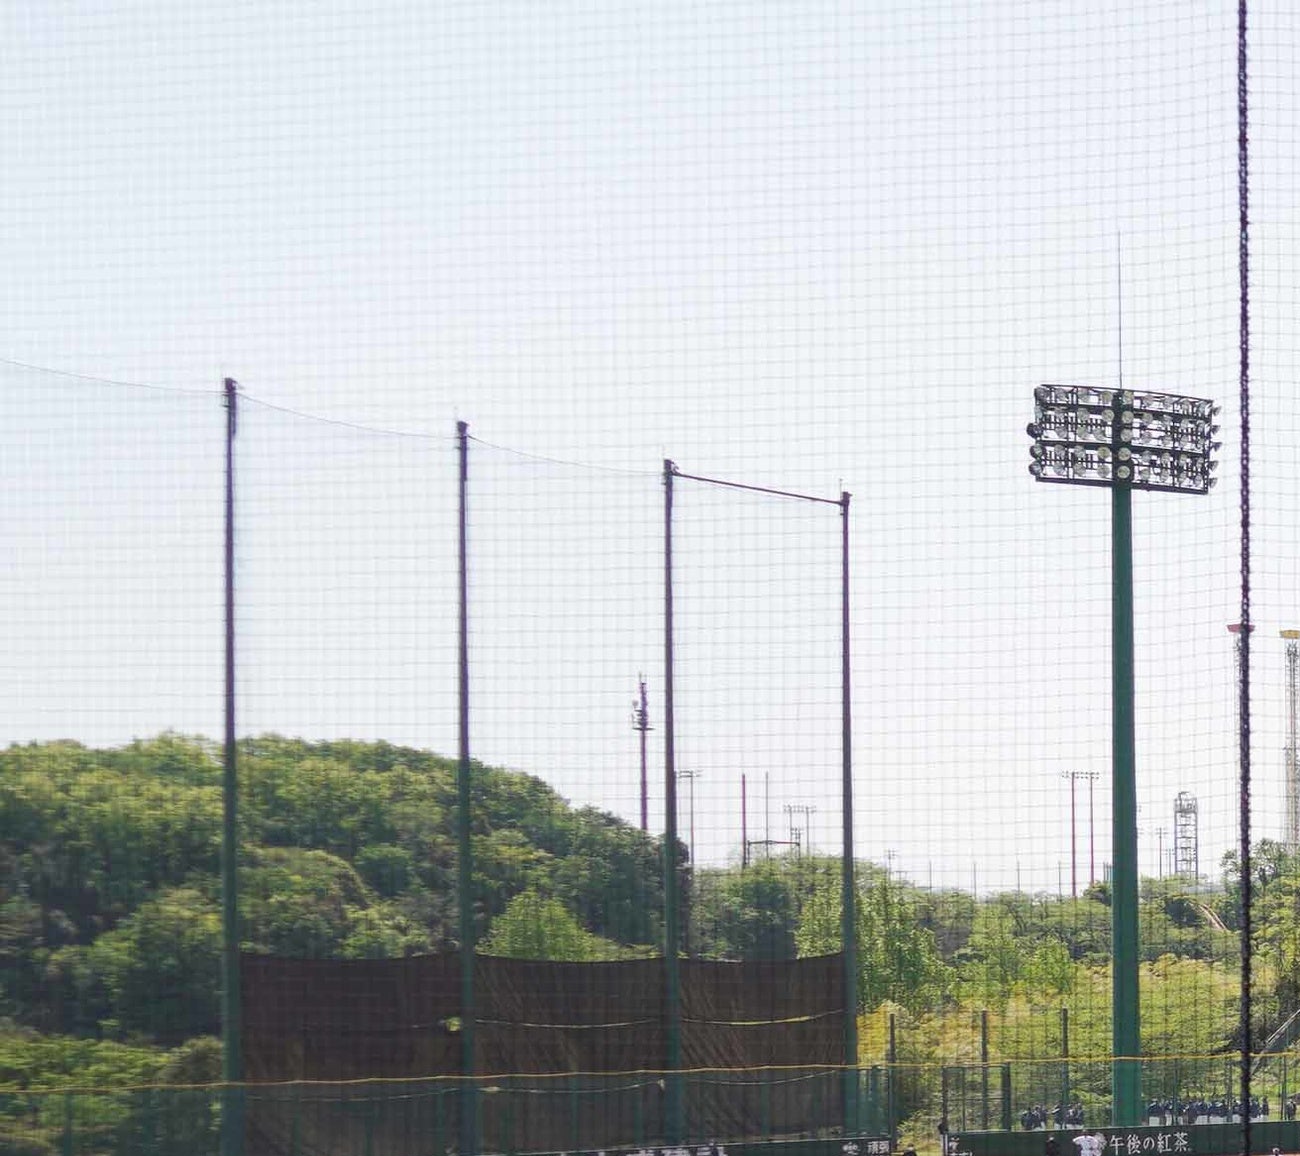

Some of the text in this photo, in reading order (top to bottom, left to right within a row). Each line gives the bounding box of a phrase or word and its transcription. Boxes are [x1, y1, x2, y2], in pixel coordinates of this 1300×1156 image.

[1109, 1131, 1190, 1156] 午後の紅茶
